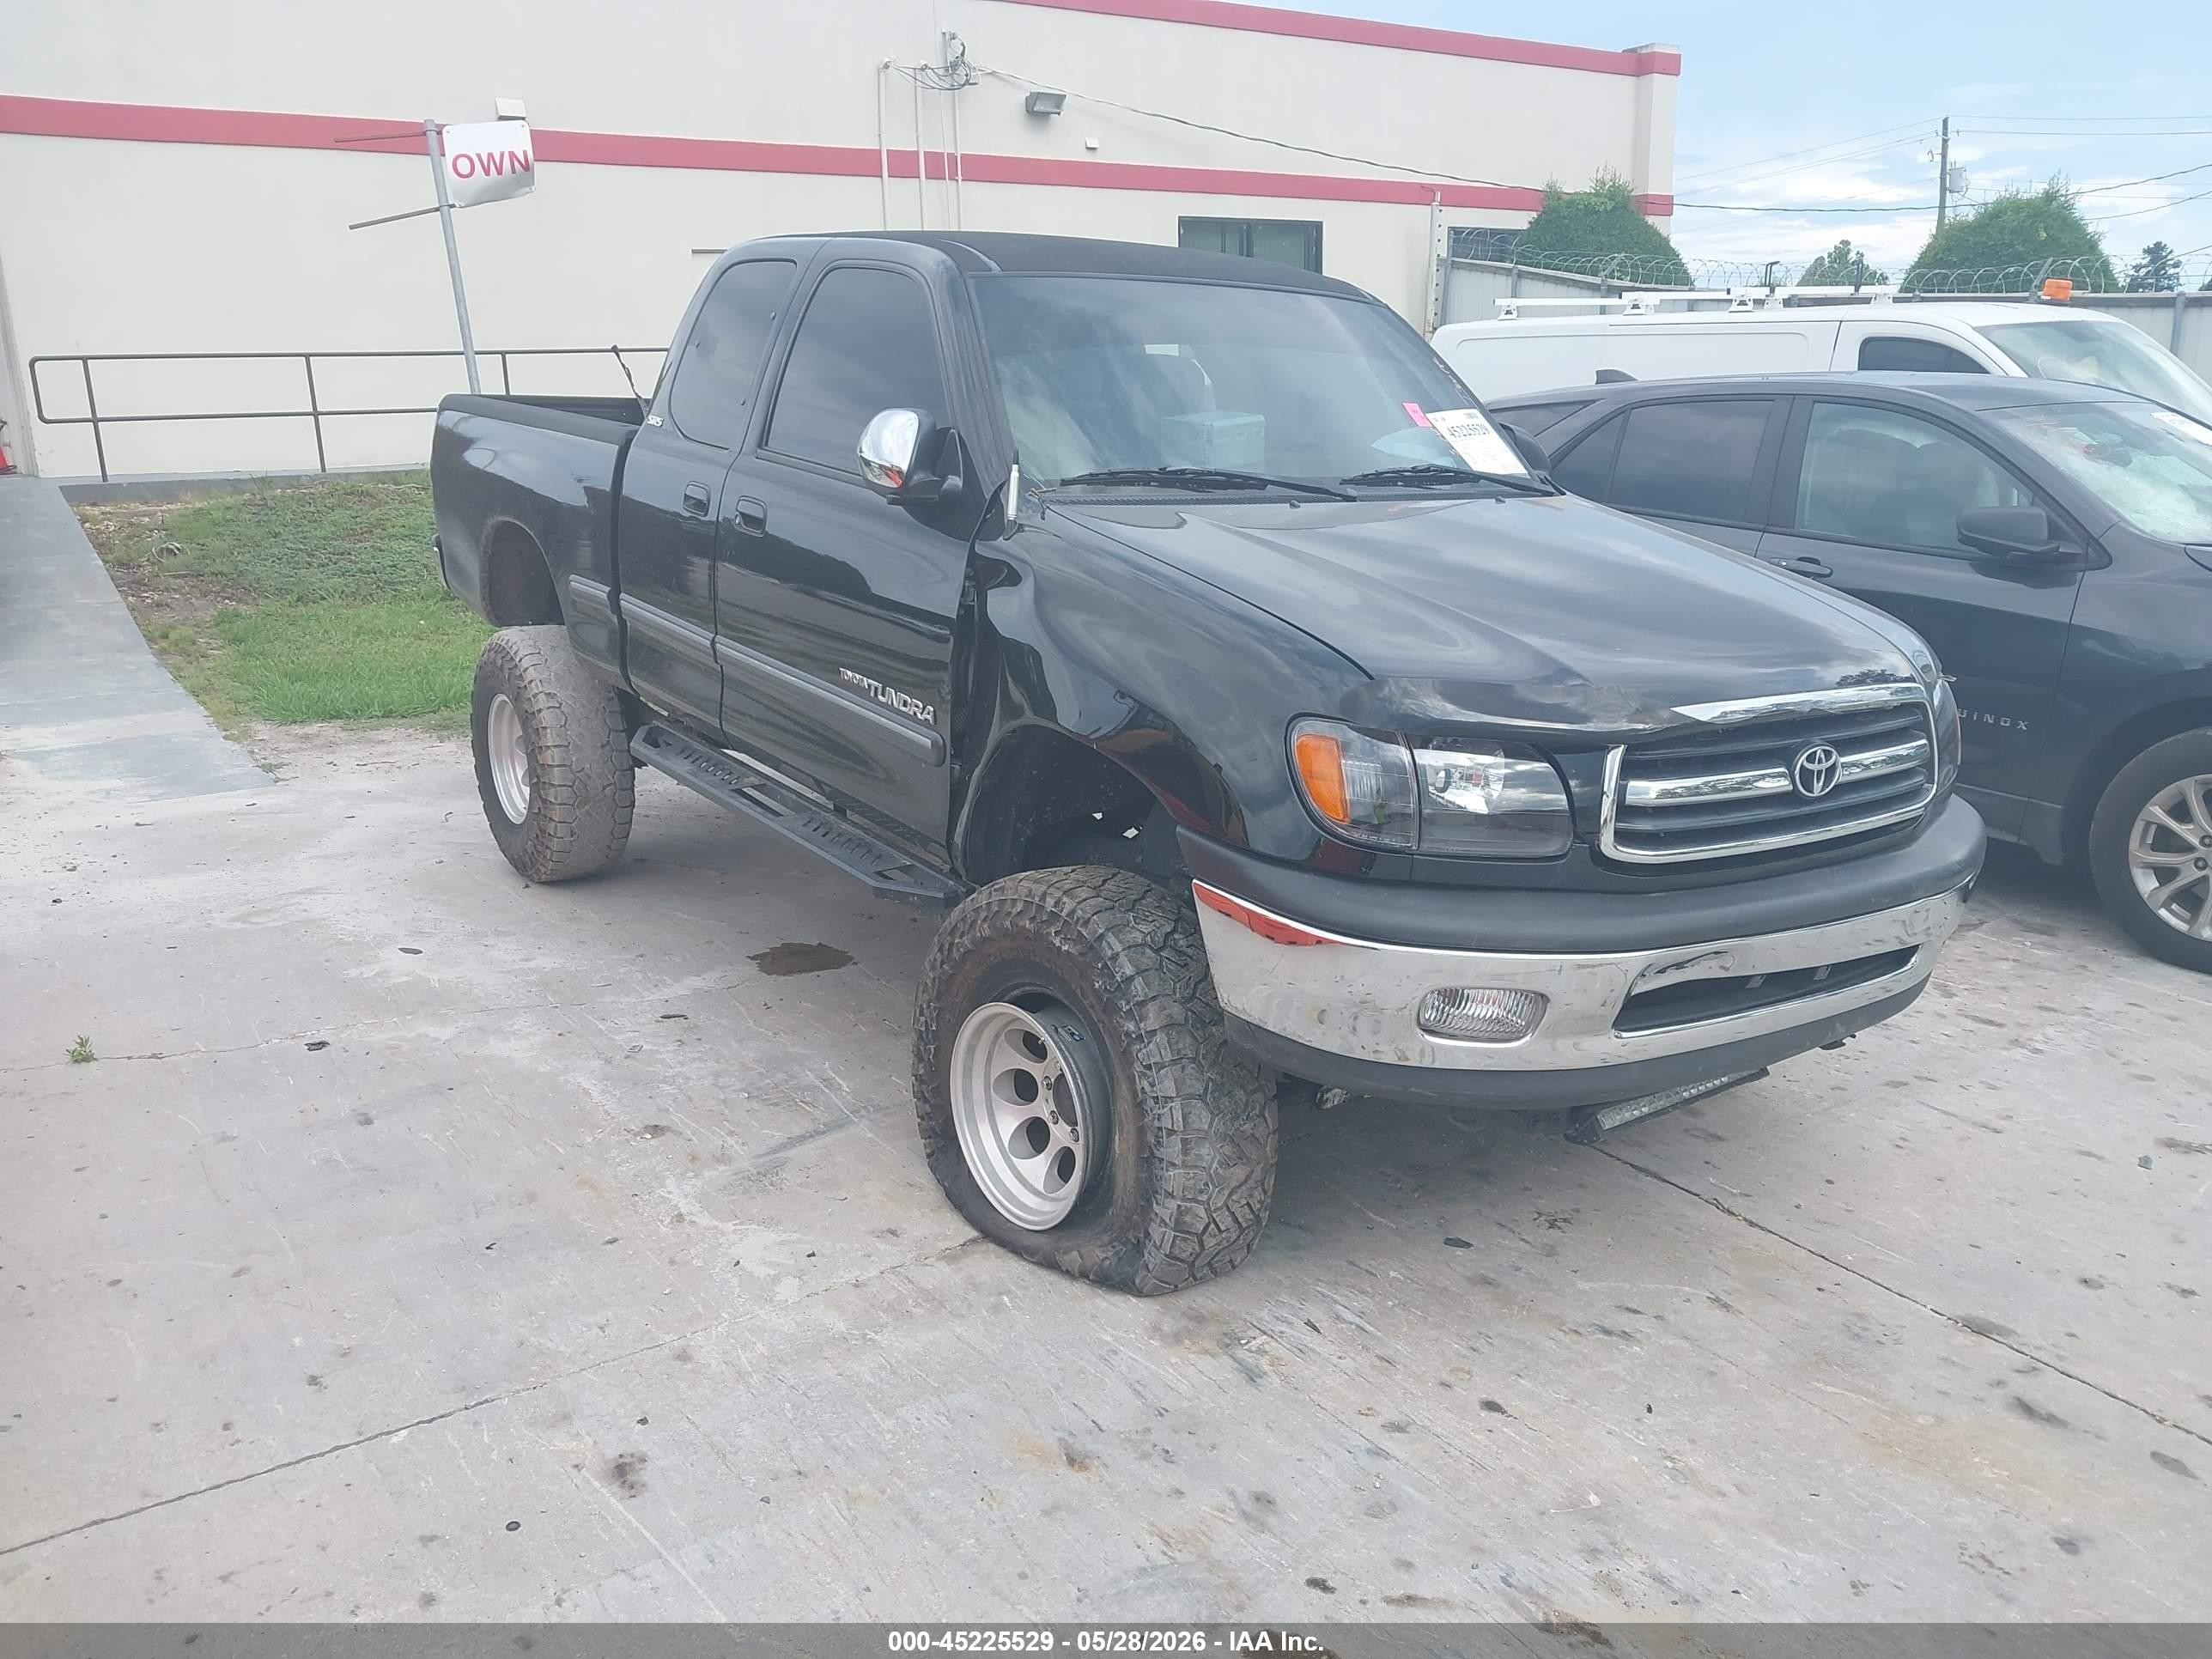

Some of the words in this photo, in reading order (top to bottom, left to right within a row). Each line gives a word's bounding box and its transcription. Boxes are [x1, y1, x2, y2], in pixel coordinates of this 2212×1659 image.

[452, 149, 531, 179] OWN
[839, 667, 868, 689] TOYOTA
[867, 677, 935, 726] TUNDRA
